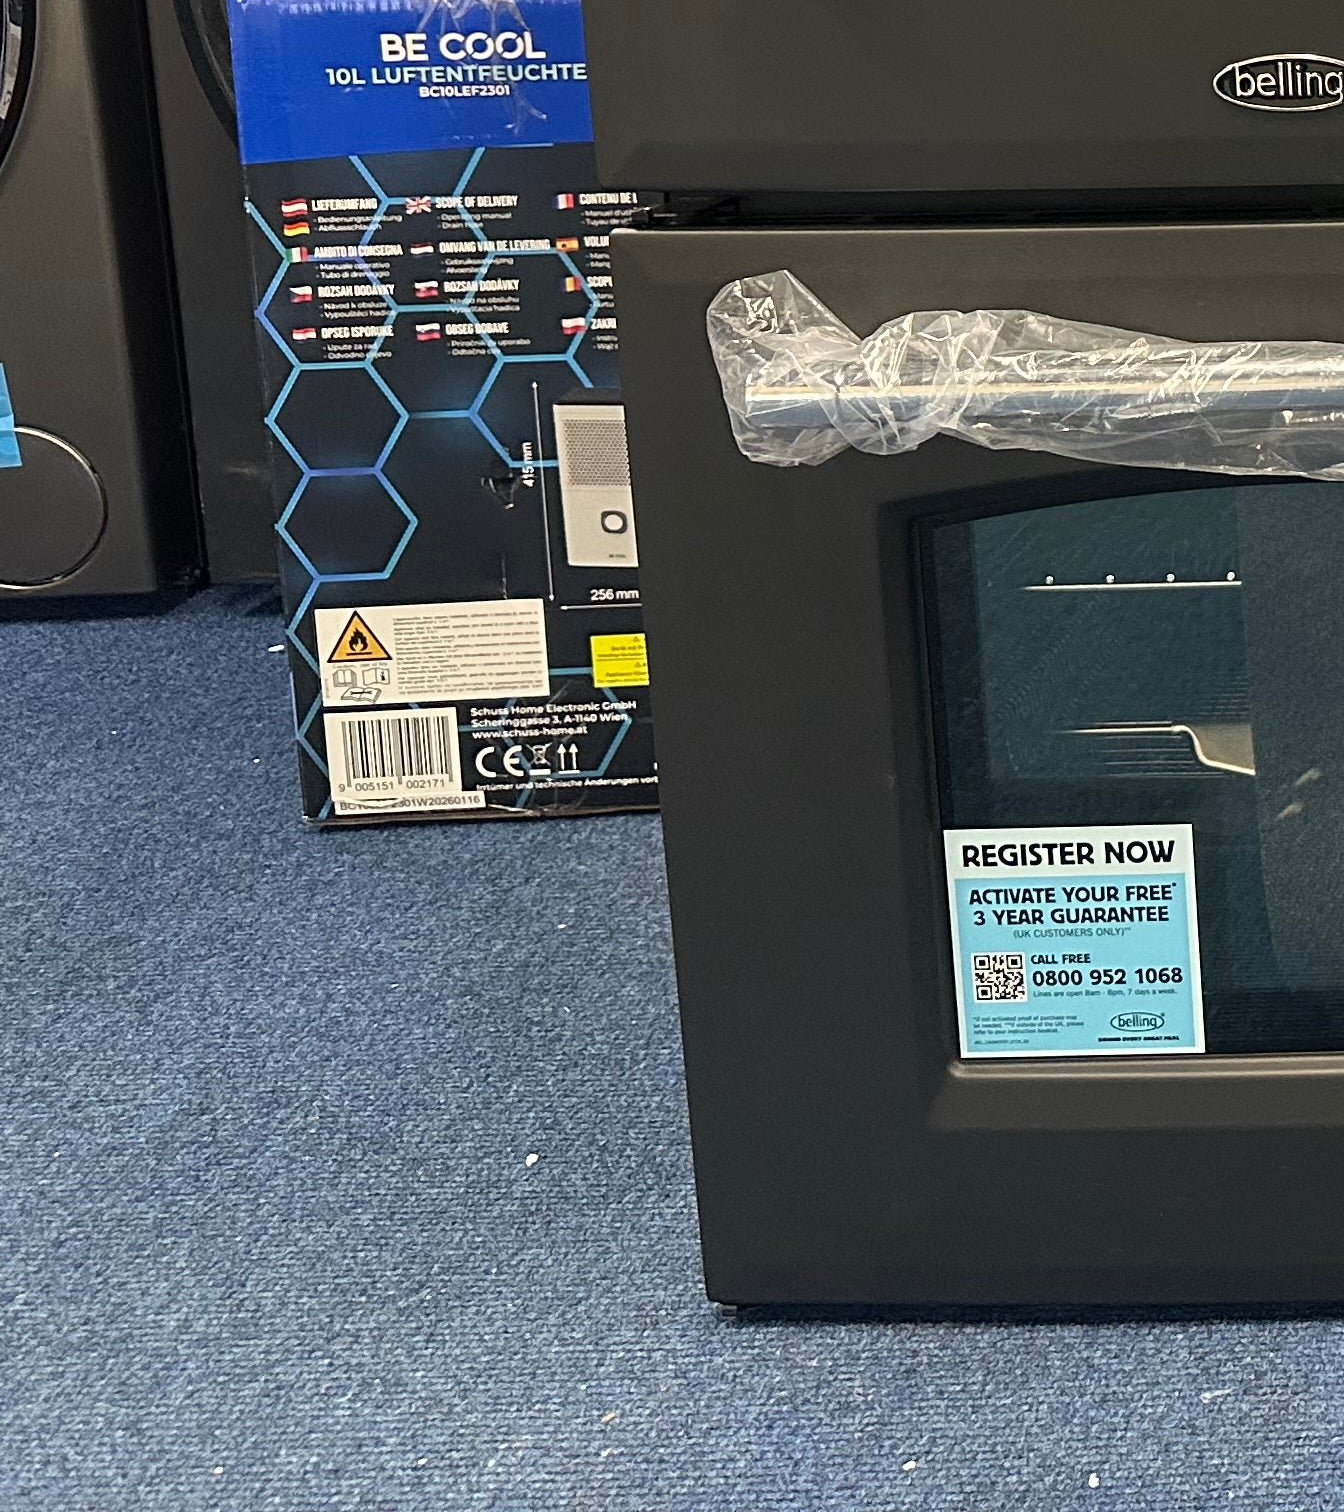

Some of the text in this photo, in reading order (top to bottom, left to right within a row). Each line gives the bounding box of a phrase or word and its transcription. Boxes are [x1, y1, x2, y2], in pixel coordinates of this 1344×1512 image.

[379, 31, 547, 62] BE COOL
[326, 67, 366, 85] 10L
[1234, 61, 1344, 102] belling
[418, 86, 511, 98] BC10LEF2301
[435, 195, 519, 209] SCOPE OF DELIVERY
[620, 193, 633, 204] DE
[314, 244, 403, 258] AMBITO DI CONSEGNA
[522, 441, 535, 488] 415 mm
[590, 589, 640, 601] 256 mm
[470, 701, 637, 717] Schuss Home Electronic GmbH
[471, 711, 628, 728] Scheringgasse 3, A-1140 Wien
[472, 725, 588, 739] www.schuss-home.at
[338, 778, 445, 792] 9 005151 002171
[962, 840, 1175, 867] REGISTER NOW
[969, 887, 1056, 905] ACTIVATE
[1062, 885, 1119, 903] YOUR
[973, 906, 1170, 926] 3 YEAR GUARANTEE
[1013, 927, 1094, 939] (UK CUSTOMERS
[1030, 953, 1092, 965] CALL FREE
[1032, 967, 1184, 987] 0800 952 1068
[1033, 990, 1052, 998] Lines
[1117, 1014, 1158, 1029] belling
